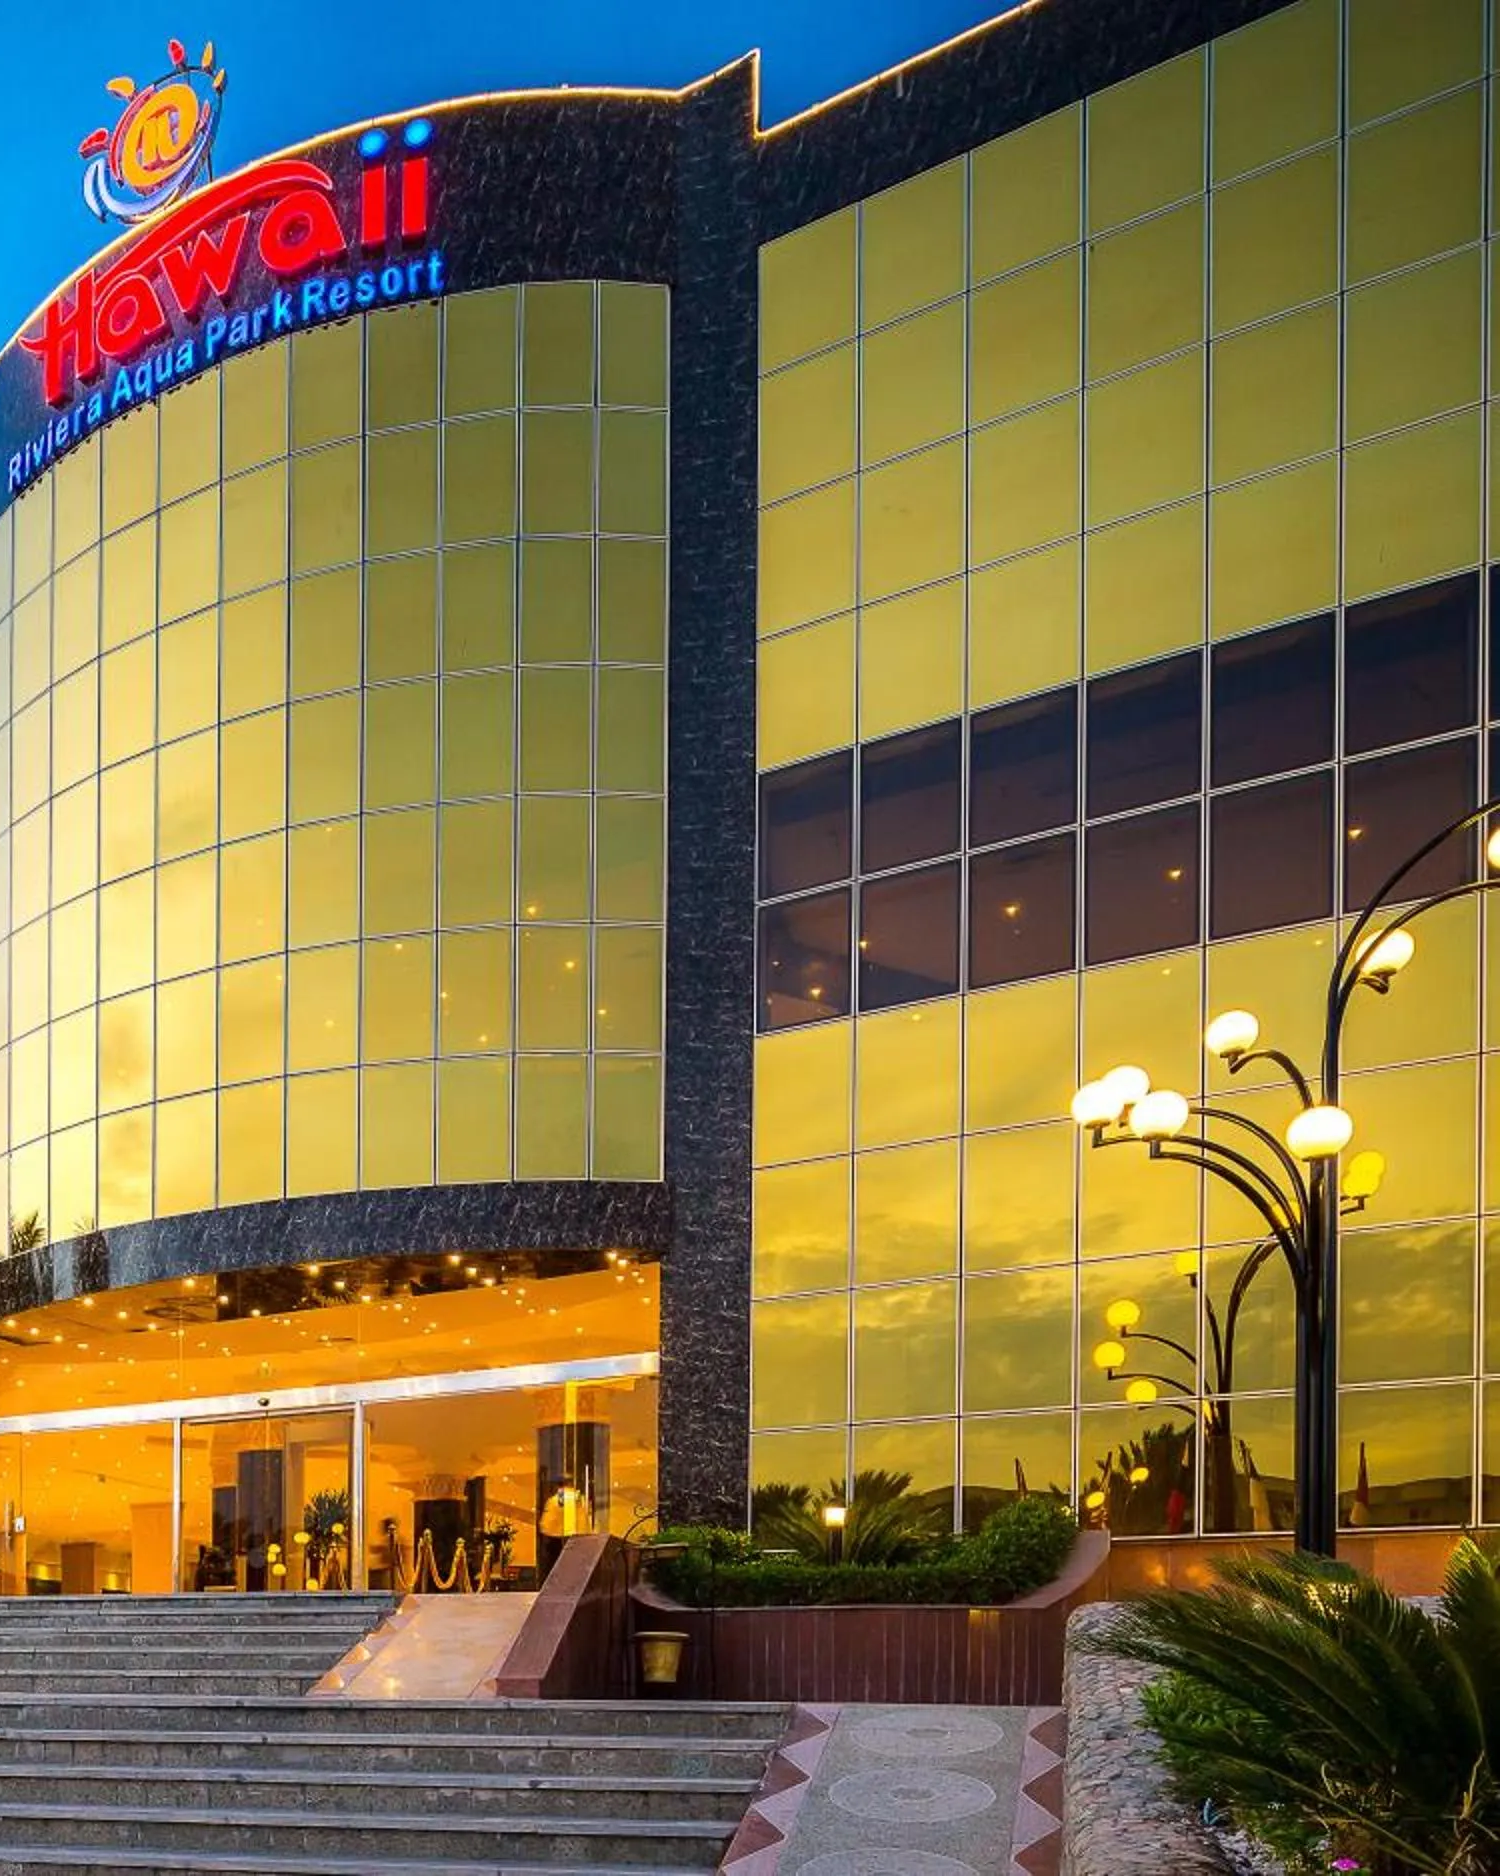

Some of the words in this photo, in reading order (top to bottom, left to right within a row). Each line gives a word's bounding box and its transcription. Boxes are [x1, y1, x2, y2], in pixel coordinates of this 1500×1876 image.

[8, 392, 102, 493] Riviera
[111, 339, 194, 410] Aqua
[205, 288, 293, 360] Park
[302, 249, 444, 321] Resort
[18, 118, 433, 406] Hawaii
